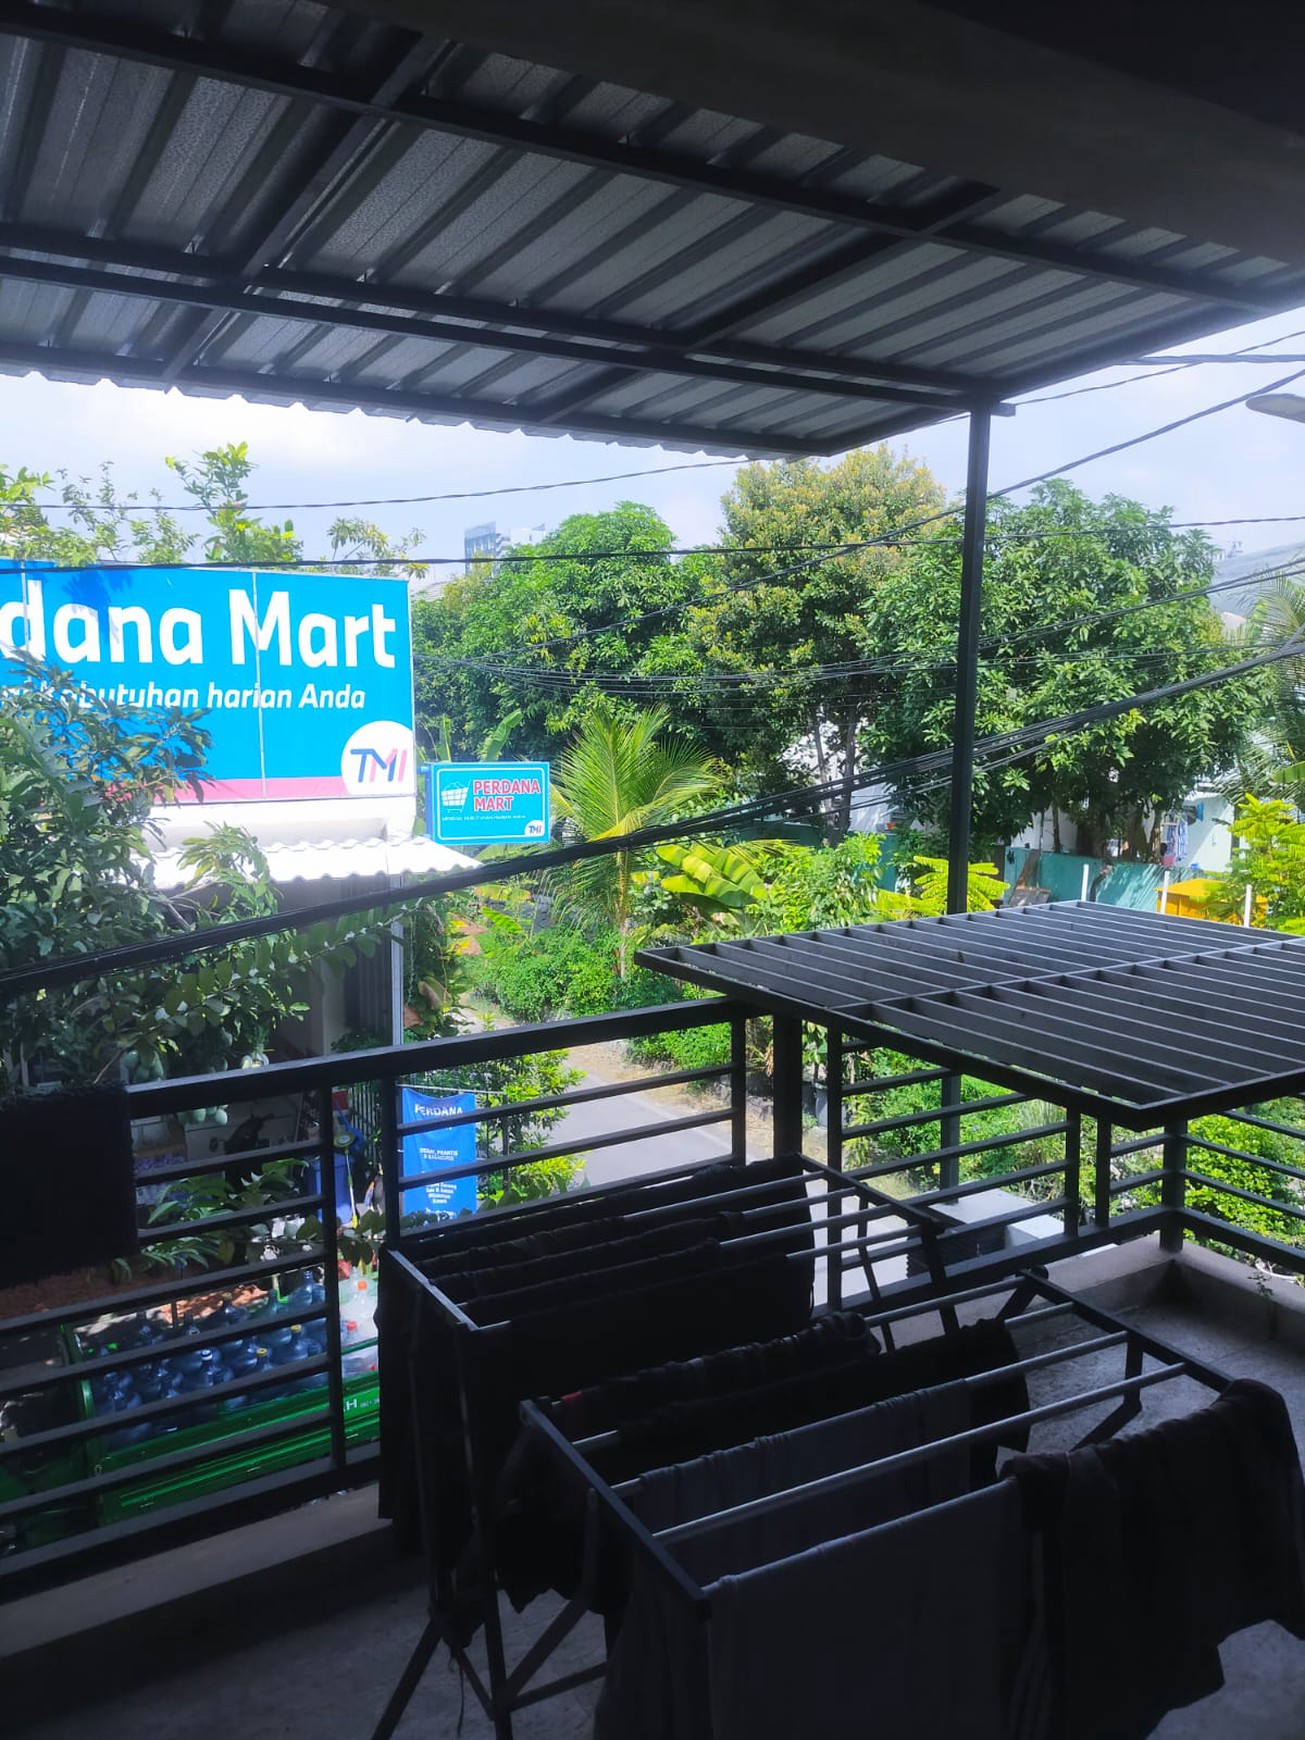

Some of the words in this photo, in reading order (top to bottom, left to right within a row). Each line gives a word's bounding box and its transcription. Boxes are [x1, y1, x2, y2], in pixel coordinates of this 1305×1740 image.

[229, 588, 396, 668] Mart
[208, 682, 291, 708] harian
[298, 683, 366, 709] Anda
[473, 780, 540, 795] PERDANA
[474, 796, 513, 812] MART
